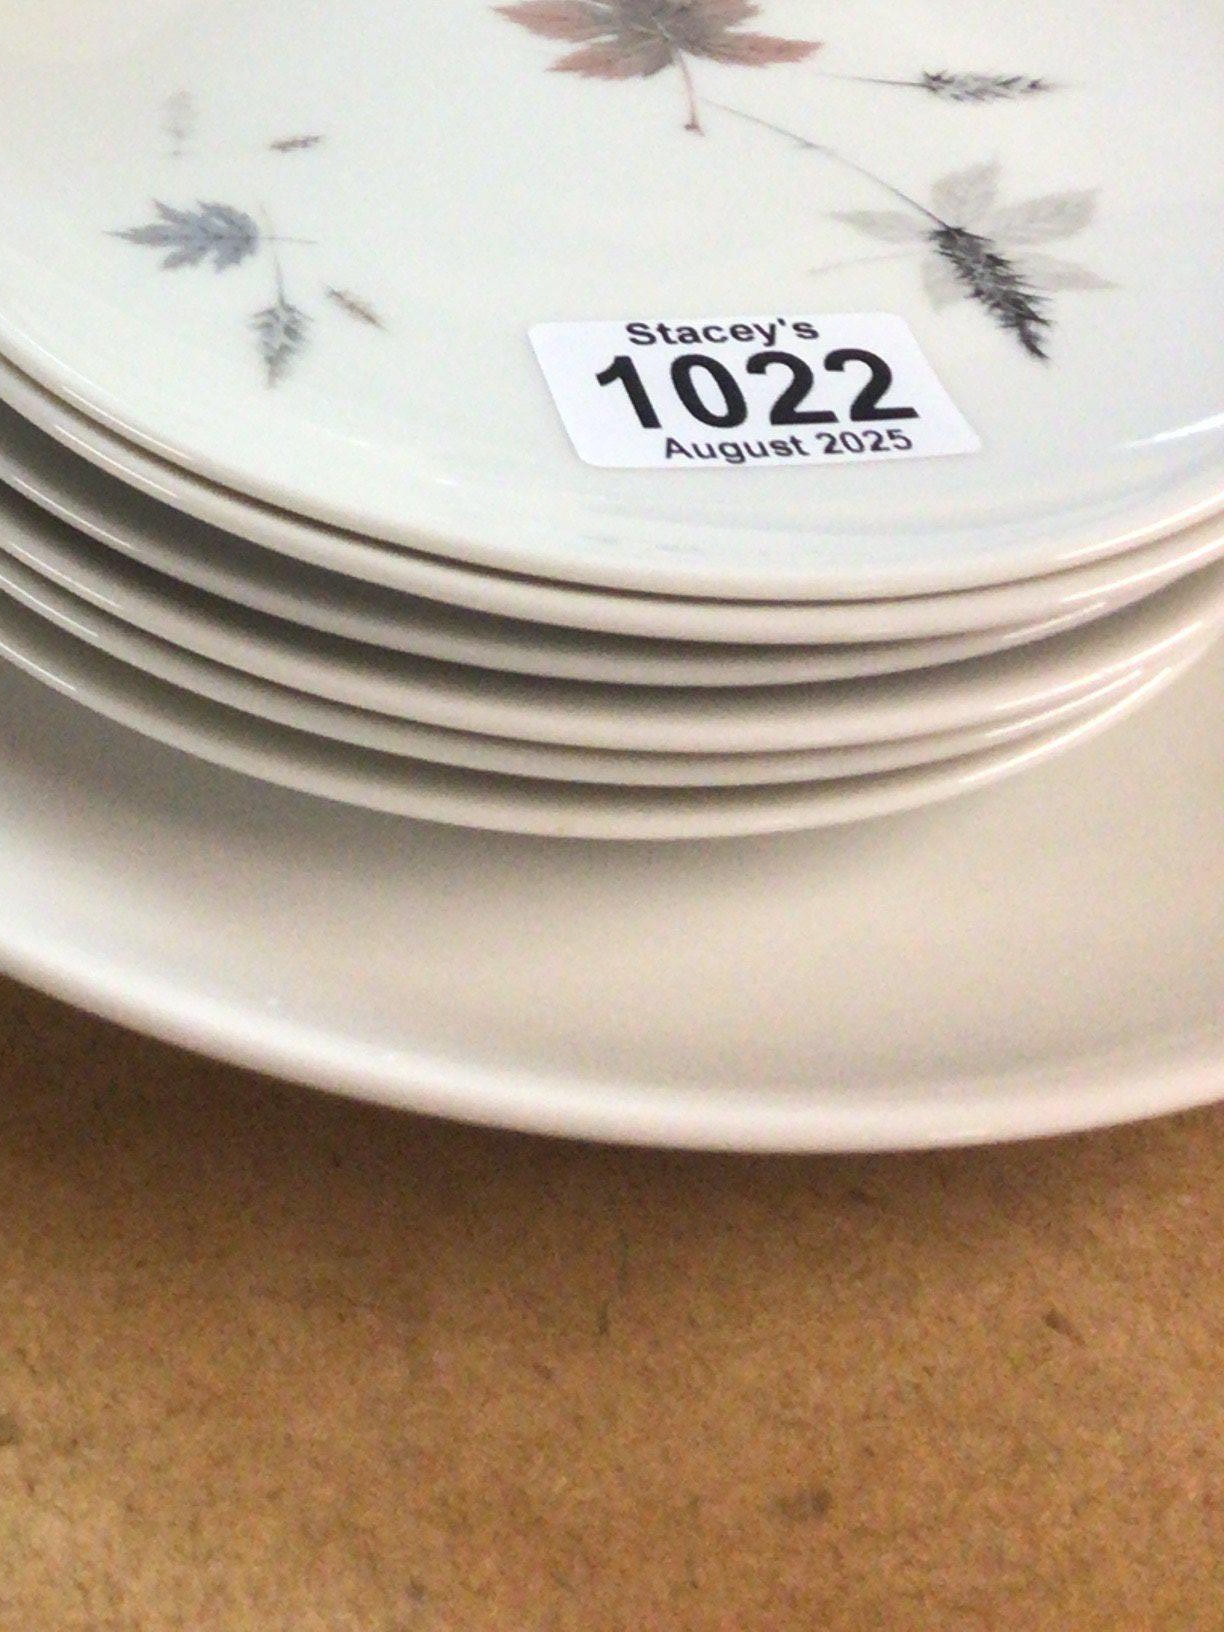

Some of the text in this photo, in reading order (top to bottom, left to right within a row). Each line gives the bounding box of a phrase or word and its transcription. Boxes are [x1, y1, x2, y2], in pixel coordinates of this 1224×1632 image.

[625, 318, 820, 347] Stacey's
[595, 348, 920, 429] 1022
[665, 428, 913, 465] August 2025
